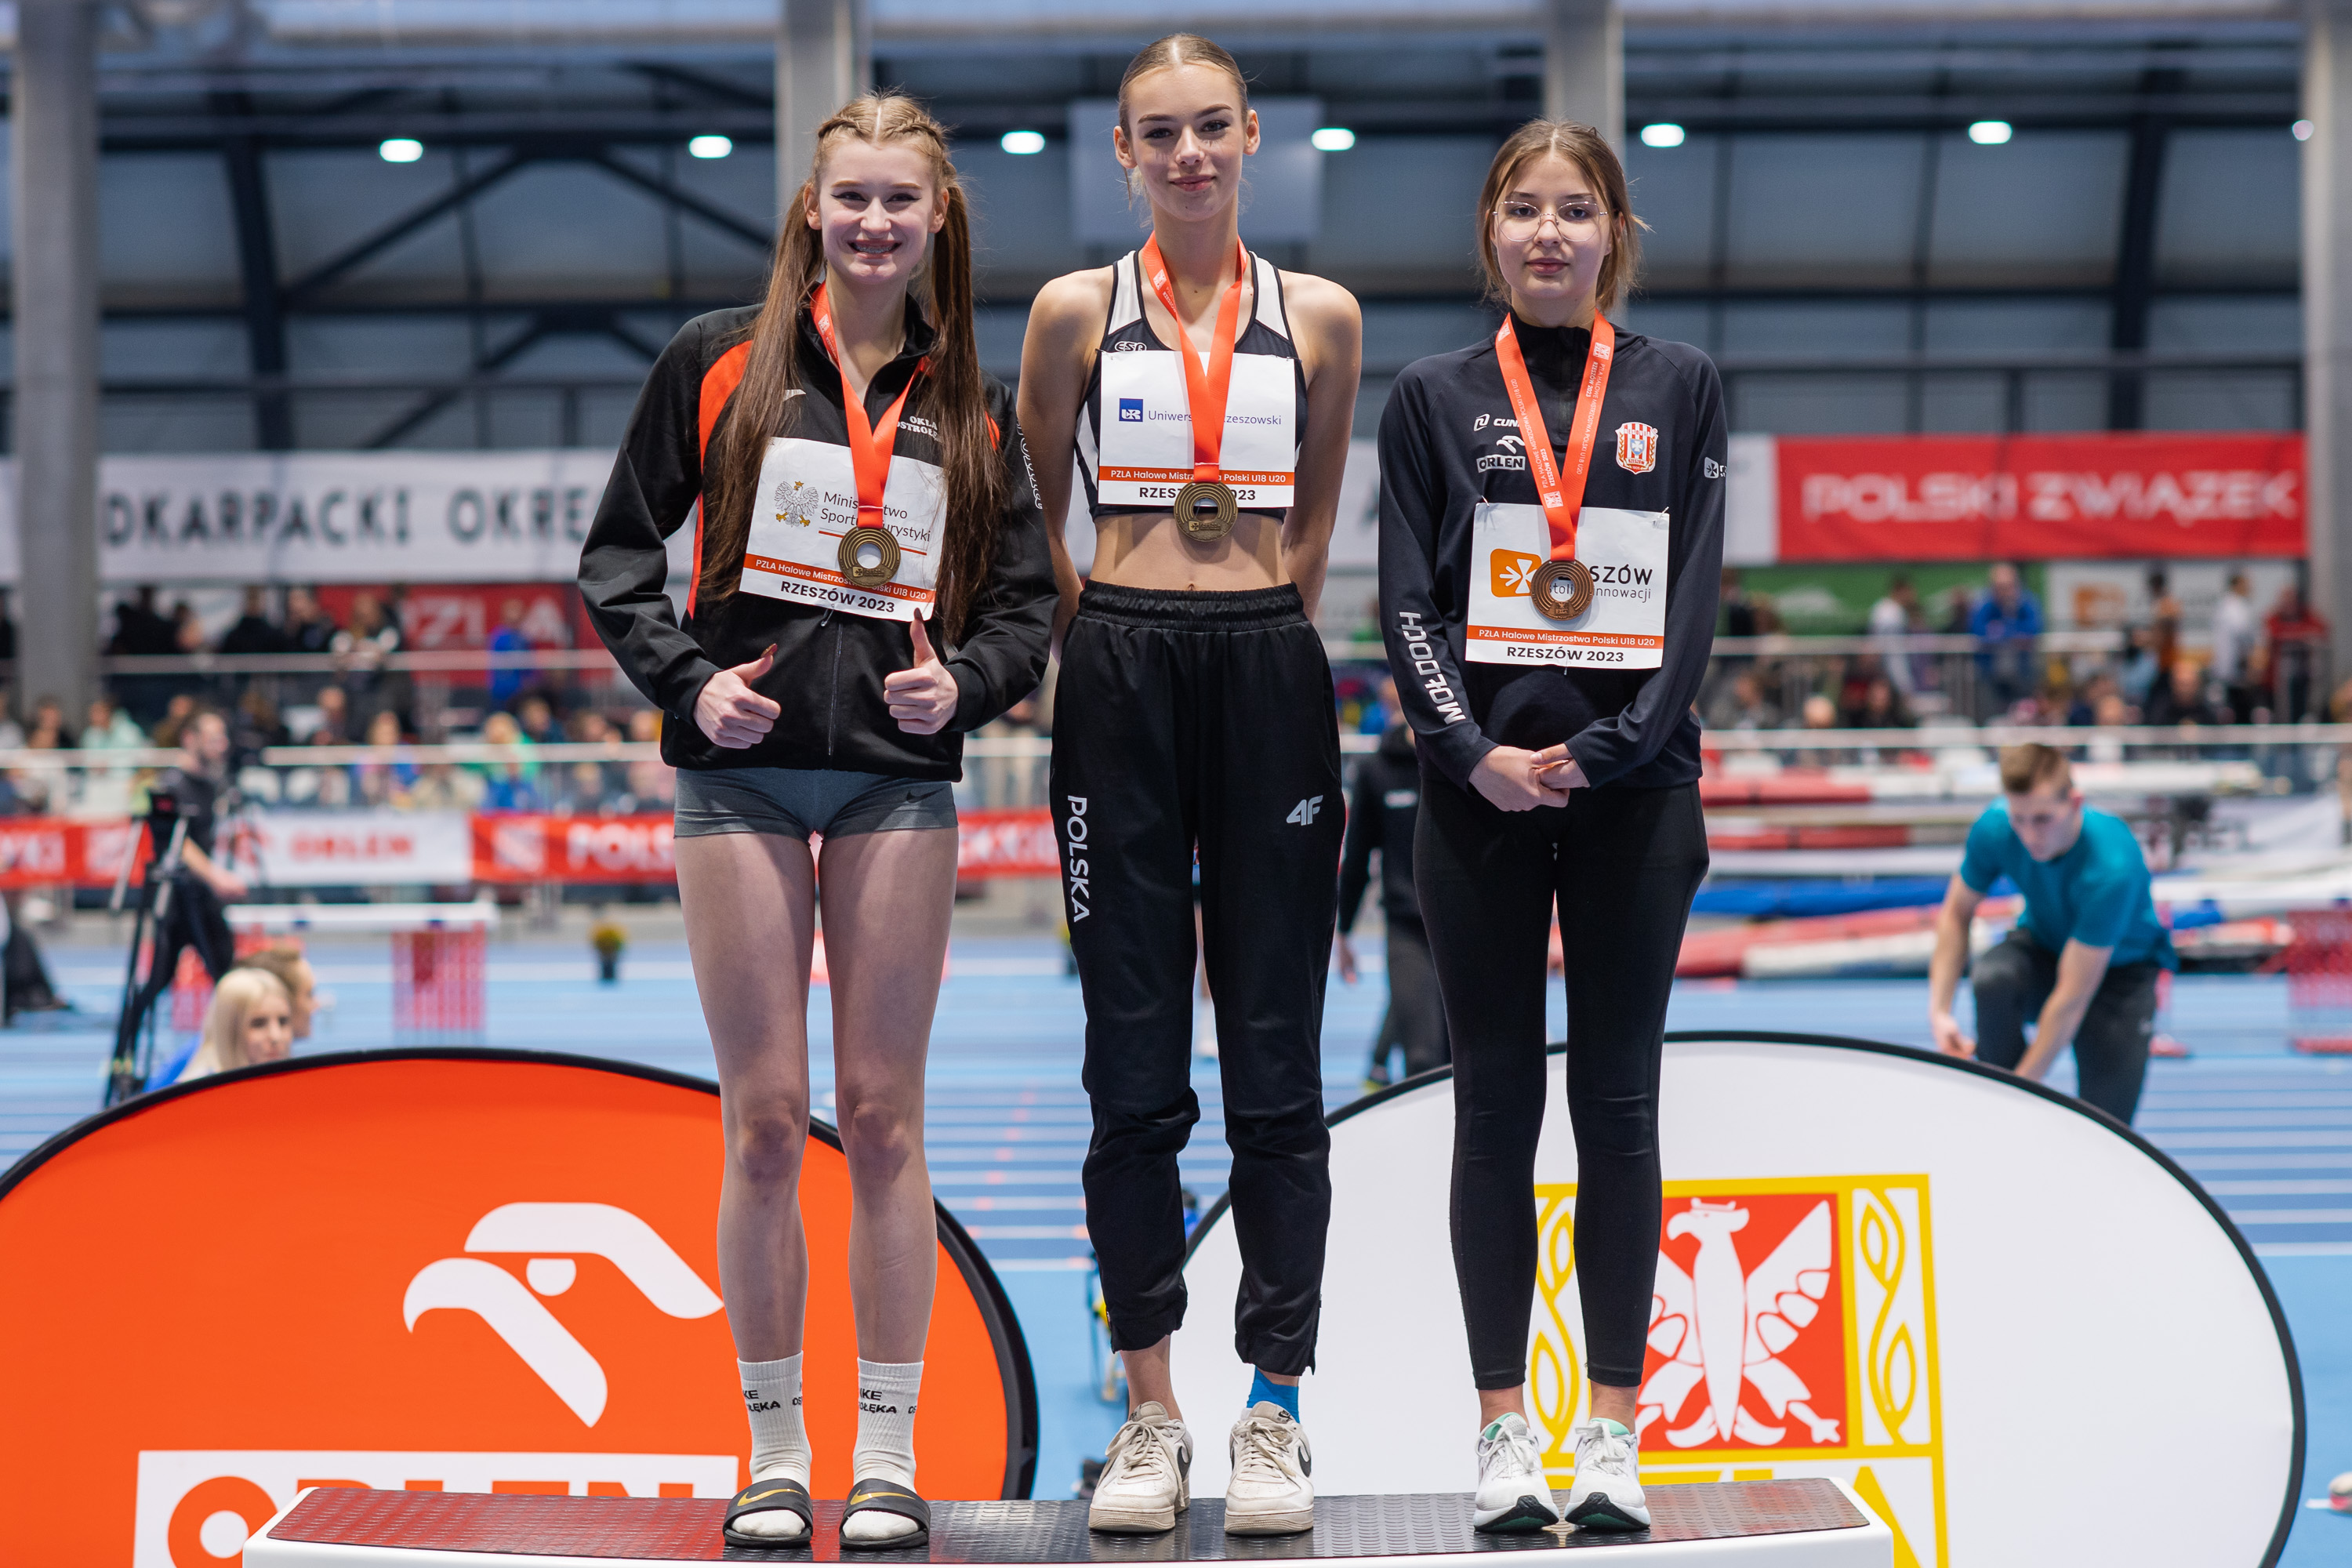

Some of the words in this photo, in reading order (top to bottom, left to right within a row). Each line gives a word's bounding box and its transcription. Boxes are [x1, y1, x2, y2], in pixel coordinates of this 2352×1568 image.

[909, 416, 938, 430] OKLA
[1148, 410, 1192, 422] Uniwers
[1225, 415, 1282, 426] zeszowski
[1493, 418, 1520, 428] CUN
[1582, 432, 1591, 452] POLSKI
[1479, 456, 1523, 470] ORLEN
[1110, 470, 1131, 478] PZLA
[1133, 470, 1167, 480] Halowe
[1224, 473, 1250, 483] Polski
[1251, 474, 1266, 483] U18
[823, 491, 908, 519] Ministwo
[1803, 472, 2017, 524] POLSKI
[103, 486, 411, 547] DKARPACKI
[820, 507, 858, 526] Sport
[884, 521, 931, 542] urystyki
[756, 558, 776, 571] PZLA
[778, 562, 811, 577] Halowe
[893, 586, 908, 597] U18
[909, 590, 927, 601] U20
[1588, 564, 1653, 586] SZÓW
[780, 580, 856, 606] RZESZÓW
[858, 594, 895, 613] 2023
[1479, 629, 1500, 638] PZLA
[1501, 630, 1536, 641] Halowe
[1537, 632, 1591, 644] Mistrzostwa
[1592, 635, 1618, 645] Polski
[1621, 637, 1636, 645] U18
[1638, 637, 1655, 647] U20
[1507, 645, 1583, 660] RZESZÓW
[1587, 651, 1624, 662] 2023
[1399, 612, 1466, 725] MOŁDOCH
[1286, 794, 1323, 826] 4F
[1066, 795, 1090, 923] POLSKA
